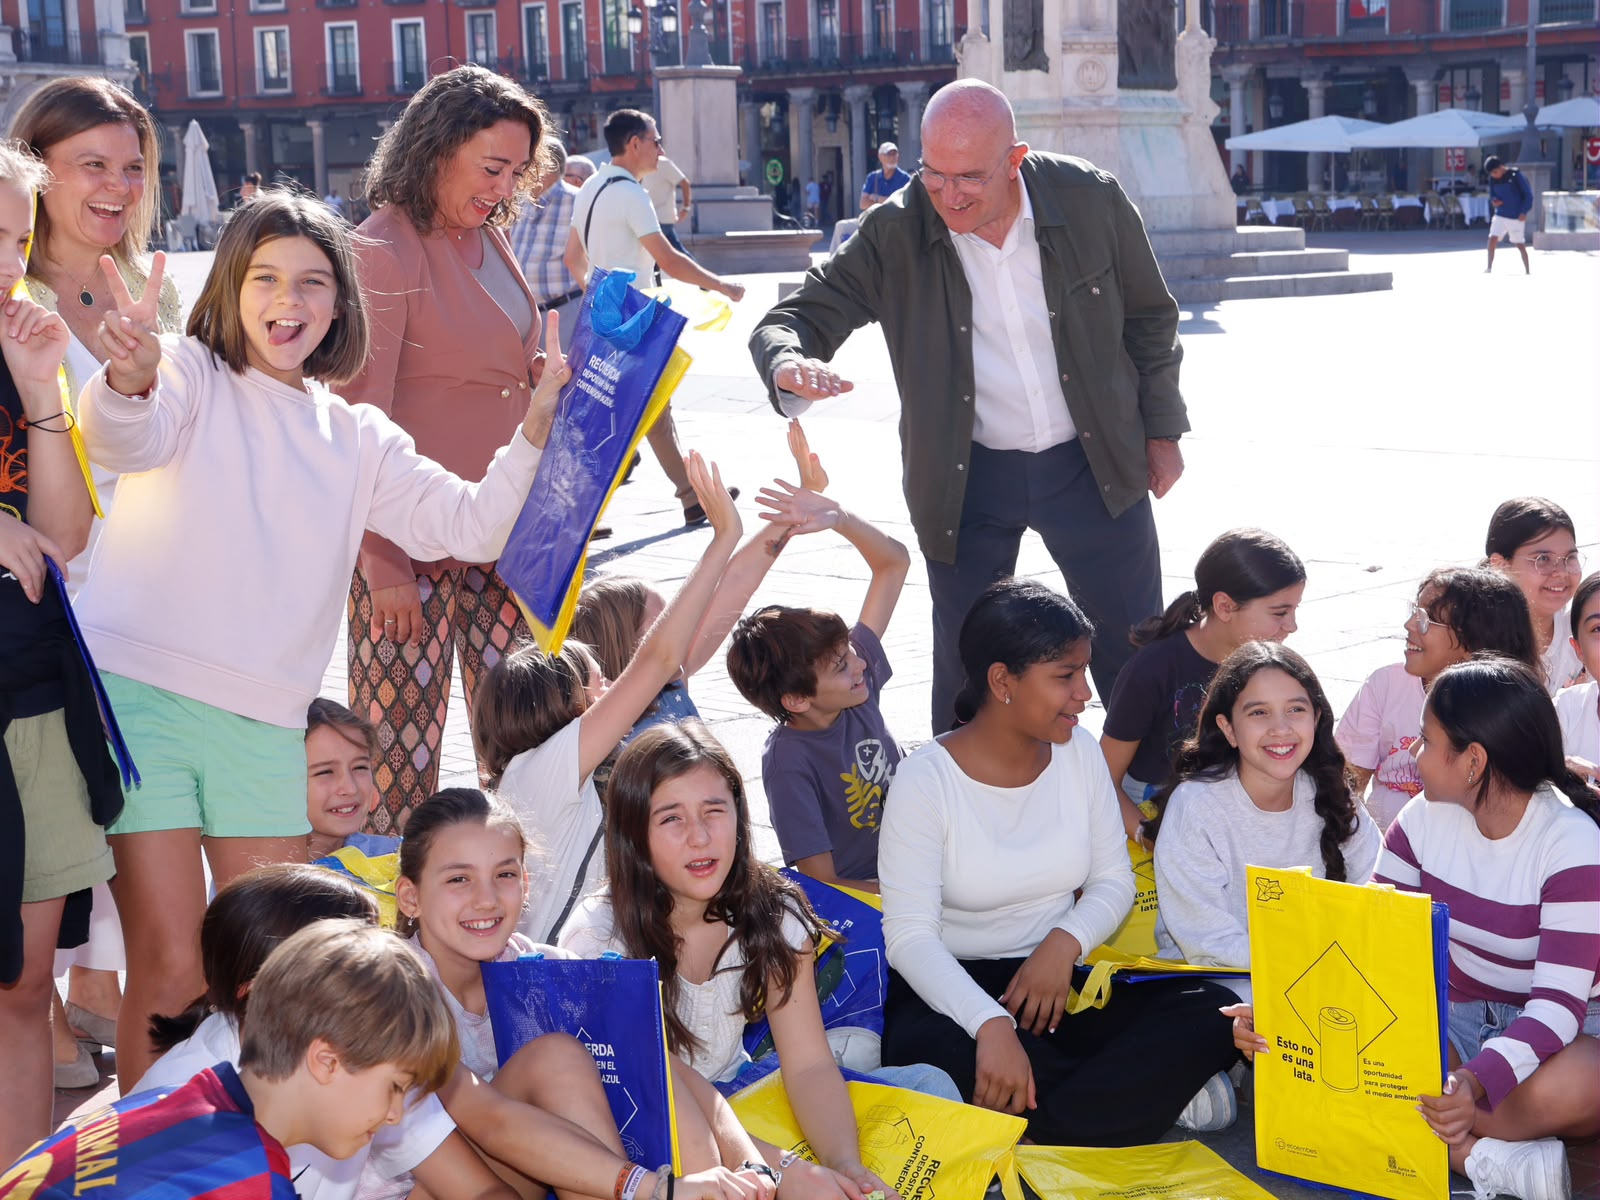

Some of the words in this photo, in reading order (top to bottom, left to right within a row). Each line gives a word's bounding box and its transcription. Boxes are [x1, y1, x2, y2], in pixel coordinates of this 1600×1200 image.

[585, 1043, 615, 1057] ERDA
[1277, 1035, 1299, 1051] Esto
[1302, 1045, 1314, 1056] no
[596, 1061, 606, 1070] EN
[607, 1061, 616, 1070] EL
[1282, 1053, 1293, 1063] es
[1296, 1057, 1314, 1070] una
[601, 1074, 620, 1084] AZUL
[1293, 1067, 1315, 1083] lata.
[1363, 1069, 1403, 1079] oportunidad
[1380, 1082, 1408, 1091] proteger
[1372, 1091, 1393, 1099] medio
[1394, 1094, 1419, 1102] ambien
[894, 1135, 925, 1192] CONTENEDO
[910, 1159, 941, 1200] RECUE
